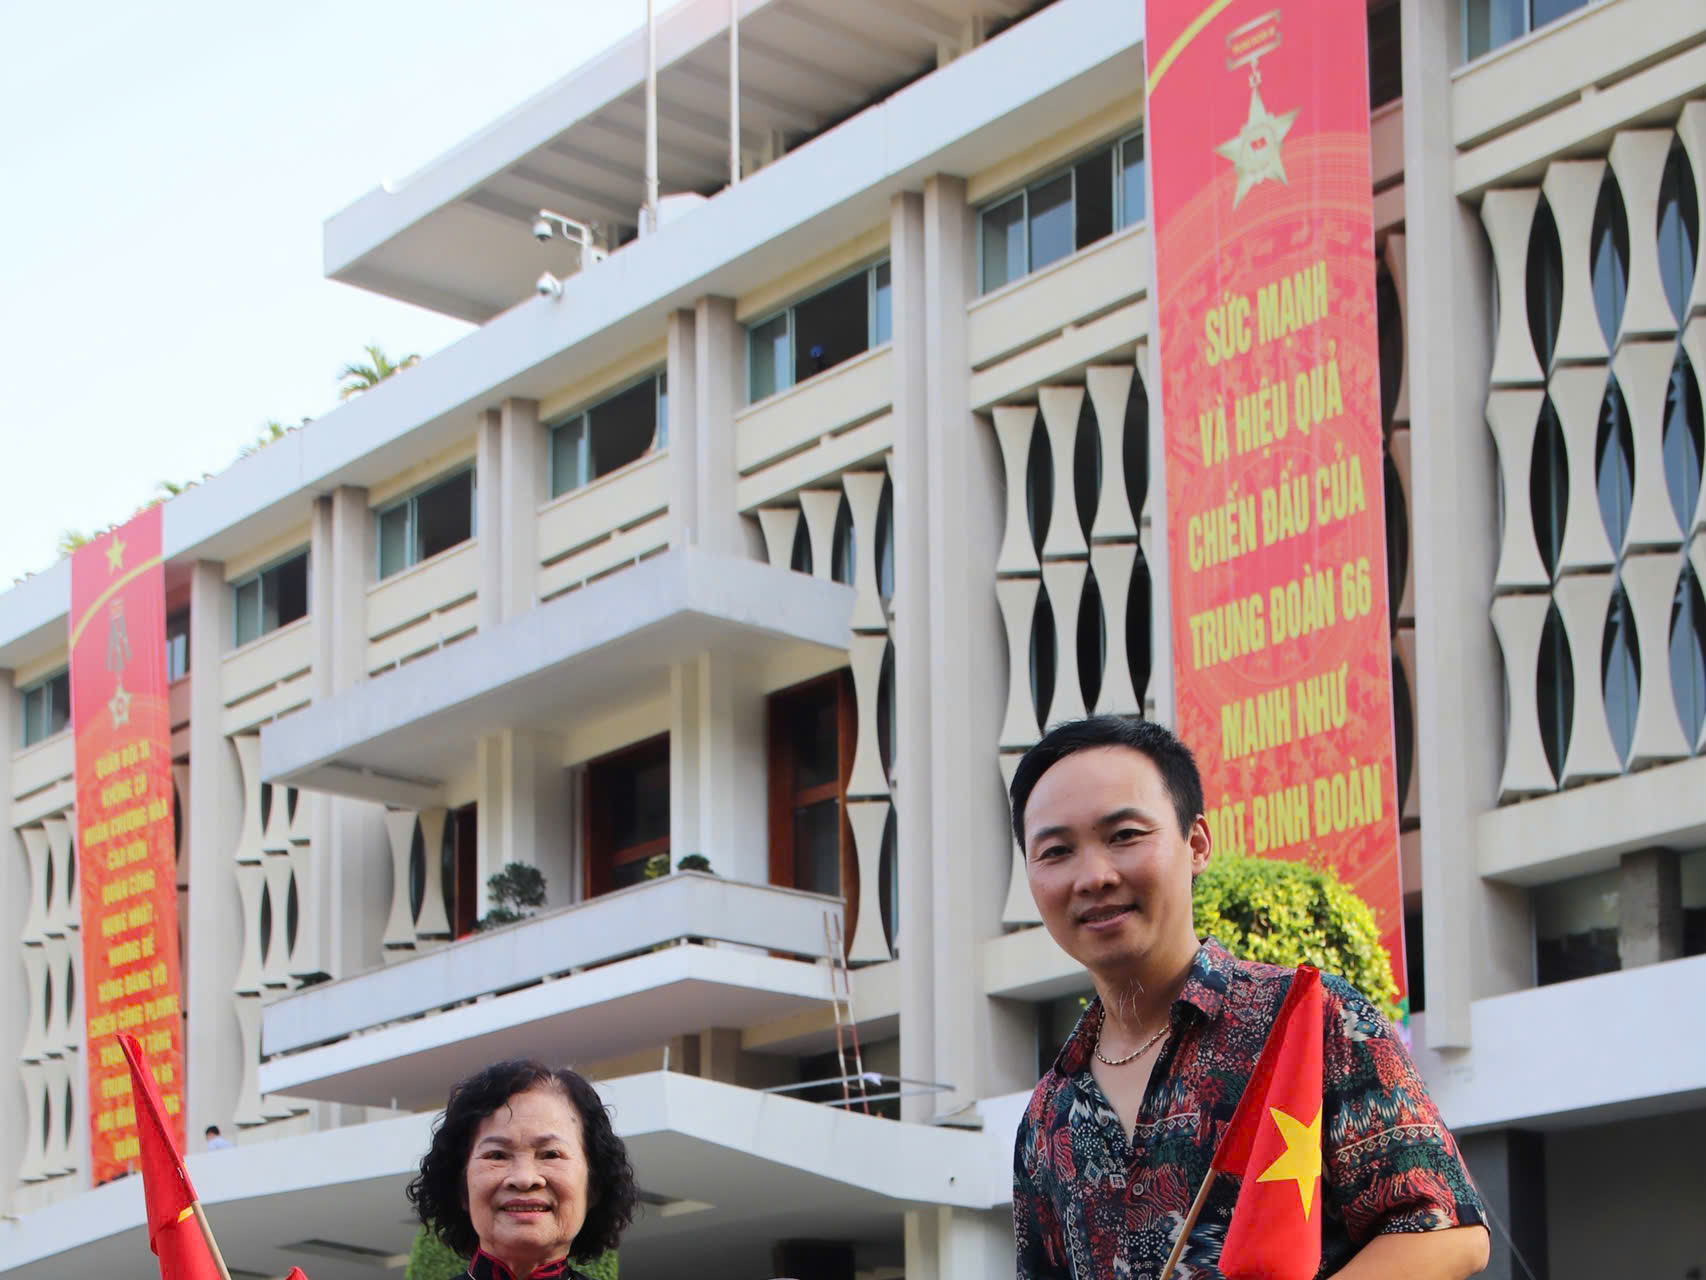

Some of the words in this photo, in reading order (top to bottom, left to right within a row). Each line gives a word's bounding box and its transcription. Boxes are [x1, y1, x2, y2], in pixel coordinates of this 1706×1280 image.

[1204, 290, 1252, 368] SỨC
[1257, 260, 1329, 348] MẠNH
[1200, 393, 1230, 469] VÀ
[1235, 376, 1289, 460] HIỆU
[1295, 338, 1344, 436] QUẢ
[1188, 480, 1258, 573] CHIẾN
[1261, 458, 1310, 547] ĐẤU
[1315, 440, 1367, 526] CỦA
[1189, 592, 1266, 671] TRUNG
[1270, 563, 1336, 645] ĐOÀN
[1341, 556, 1373, 622] 66
[1221, 686, 1292, 769] MẠNH
[1296, 660, 1348, 740] NHƯ
[1253, 784, 1310, 853] BINH
[1314, 757, 1383, 838] ĐOÀN
